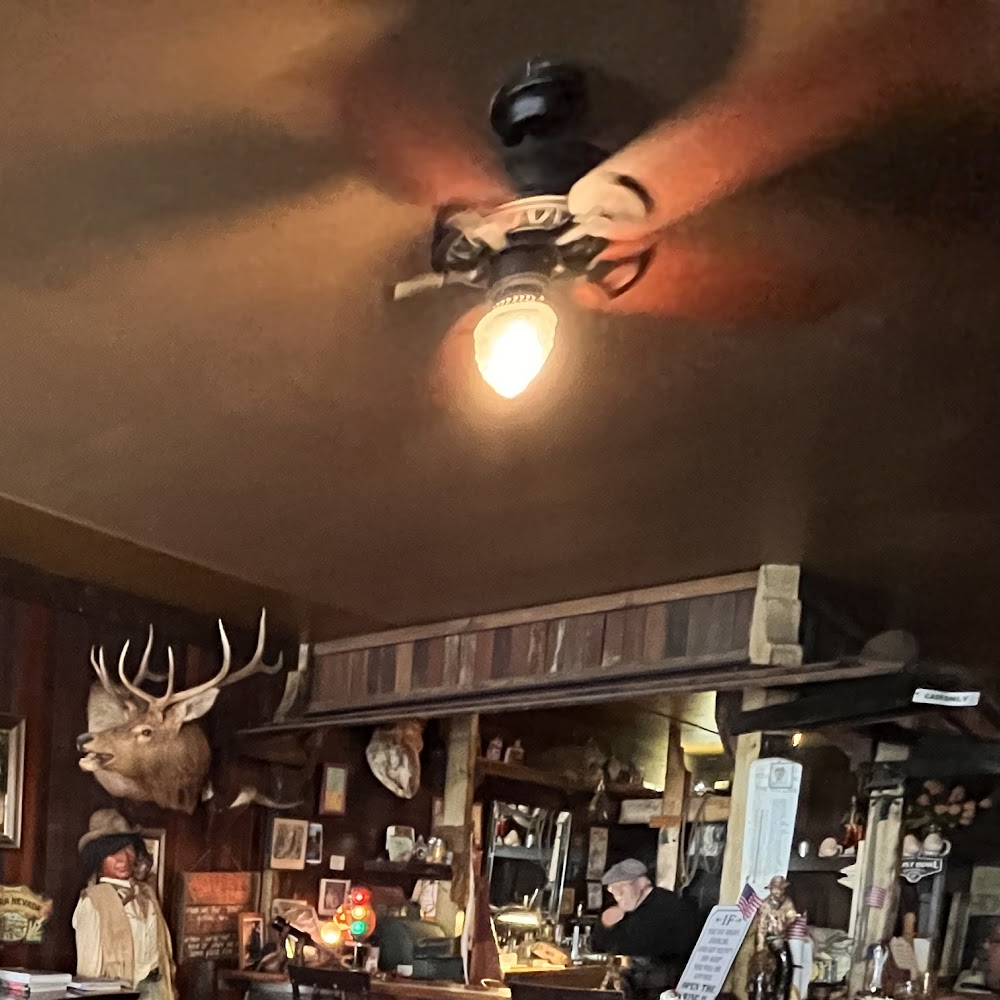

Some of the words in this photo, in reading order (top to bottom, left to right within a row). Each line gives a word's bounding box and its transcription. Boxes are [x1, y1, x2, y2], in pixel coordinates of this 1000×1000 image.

[11, 897, 42, 911] NEVADA
[682, 982, 699, 991] OPEN
[701, 984, 716, 993] THE
